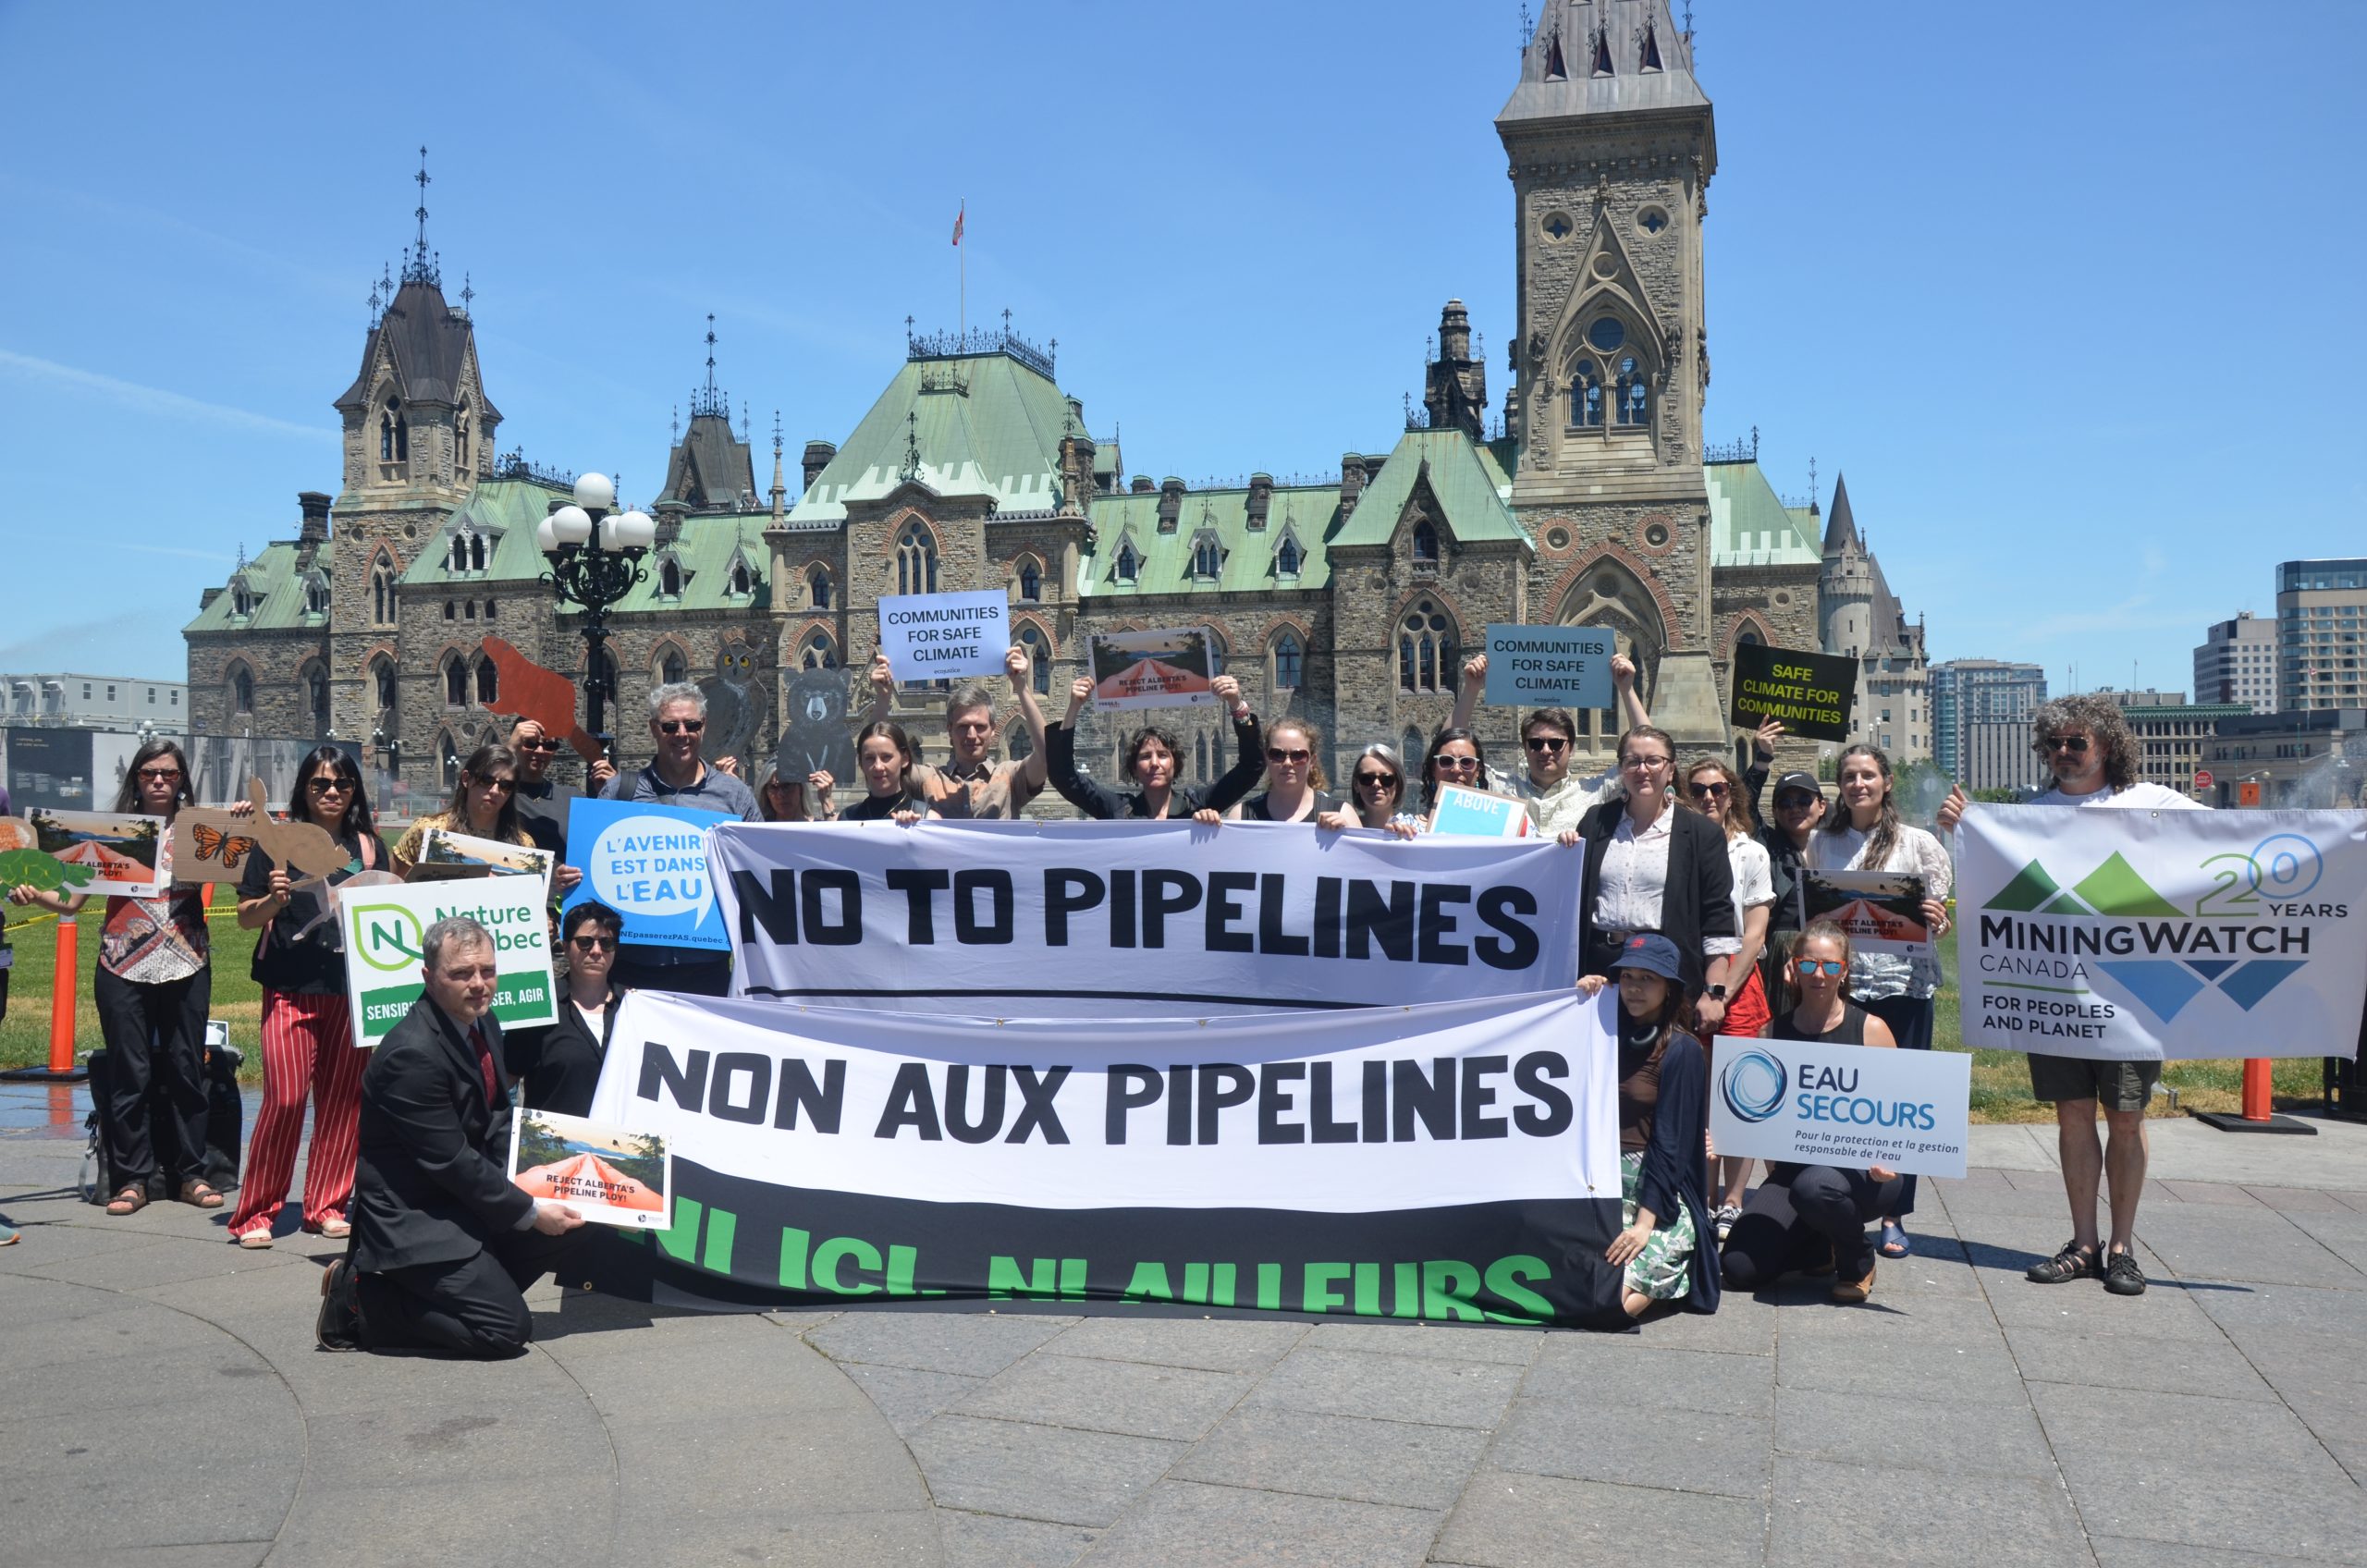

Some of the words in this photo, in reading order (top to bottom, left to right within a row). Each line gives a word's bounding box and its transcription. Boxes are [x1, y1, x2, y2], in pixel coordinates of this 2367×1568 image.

[888, 606, 999, 625] COMMUNITIES
[908, 630, 939, 643] FOR
[943, 627, 982, 640] SAFE
[914, 646, 979, 662] CLIMATE
[1494, 640, 1604, 655] COMMUNITIES
[1512, 659, 1542, 672] FOR
[1546, 659, 1585, 672] SAFE
[1772, 664, 1812, 681] SAFE
[1147, 676, 1186, 684] ALBERTA'S
[1515, 677, 1580, 691] CLIMATE
[1743, 680, 1804, 700] CLIMATE
[1807, 689, 1839, 704] FOR
[1738, 698, 1841, 724] COMMUNITIES
[1453, 792, 1500, 815] ABOVE
[607, 835, 701, 853] L'AVENIR
[611, 859, 647, 875] EST
[655, 857, 705, 872] DANS
[2196, 833, 2324, 917] 20
[616, 878, 702, 902] L'EAU
[732, 868, 863, 946] NO
[885, 868, 1014, 946] TO
[1044, 867, 1539, 971] PIPELINES
[2269, 903, 2349, 918] YEARS
[1980, 954, 2090, 980] CANADA
[366, 1000, 416, 1021] SENSIB
[519, 987, 544, 1003] AGIR
[1982, 996, 2021, 1011] FOR
[2027, 999, 2116, 1019] PEOPLES
[1982, 1015, 2023, 1031] AND
[2030, 1020, 2106, 1039] PLANET
[1798, 1064, 1858, 1093] EAU
[637, 1041, 847, 1135] NON
[874, 1062, 1073, 1145] AUX
[1106, 1050, 1573, 1145] PIPELINES
[1797, 1093, 1935, 1131] SECOURS
[1795, 1130, 1819, 1141] Pour
[1821, 1132, 1831, 1142] la
[1834, 1133, 1889, 1147] protection
[1892, 1139, 1903, 1148] et
[1906, 1140, 1916, 1149] la
[1919, 1142, 1959, 1154] gestion
[1795, 1143, 1858, 1158] responsable
[1860, 1148, 1873, 1158] de
[1876, 1150, 1902, 1161] l'eau
[546, 1174, 582, 1185] REJECT
[585, 1179, 635, 1194] ALBERTA'S
[554, 1186, 596, 1198] PIPELINE
[600, 1192, 627, 1202] PLOY!
